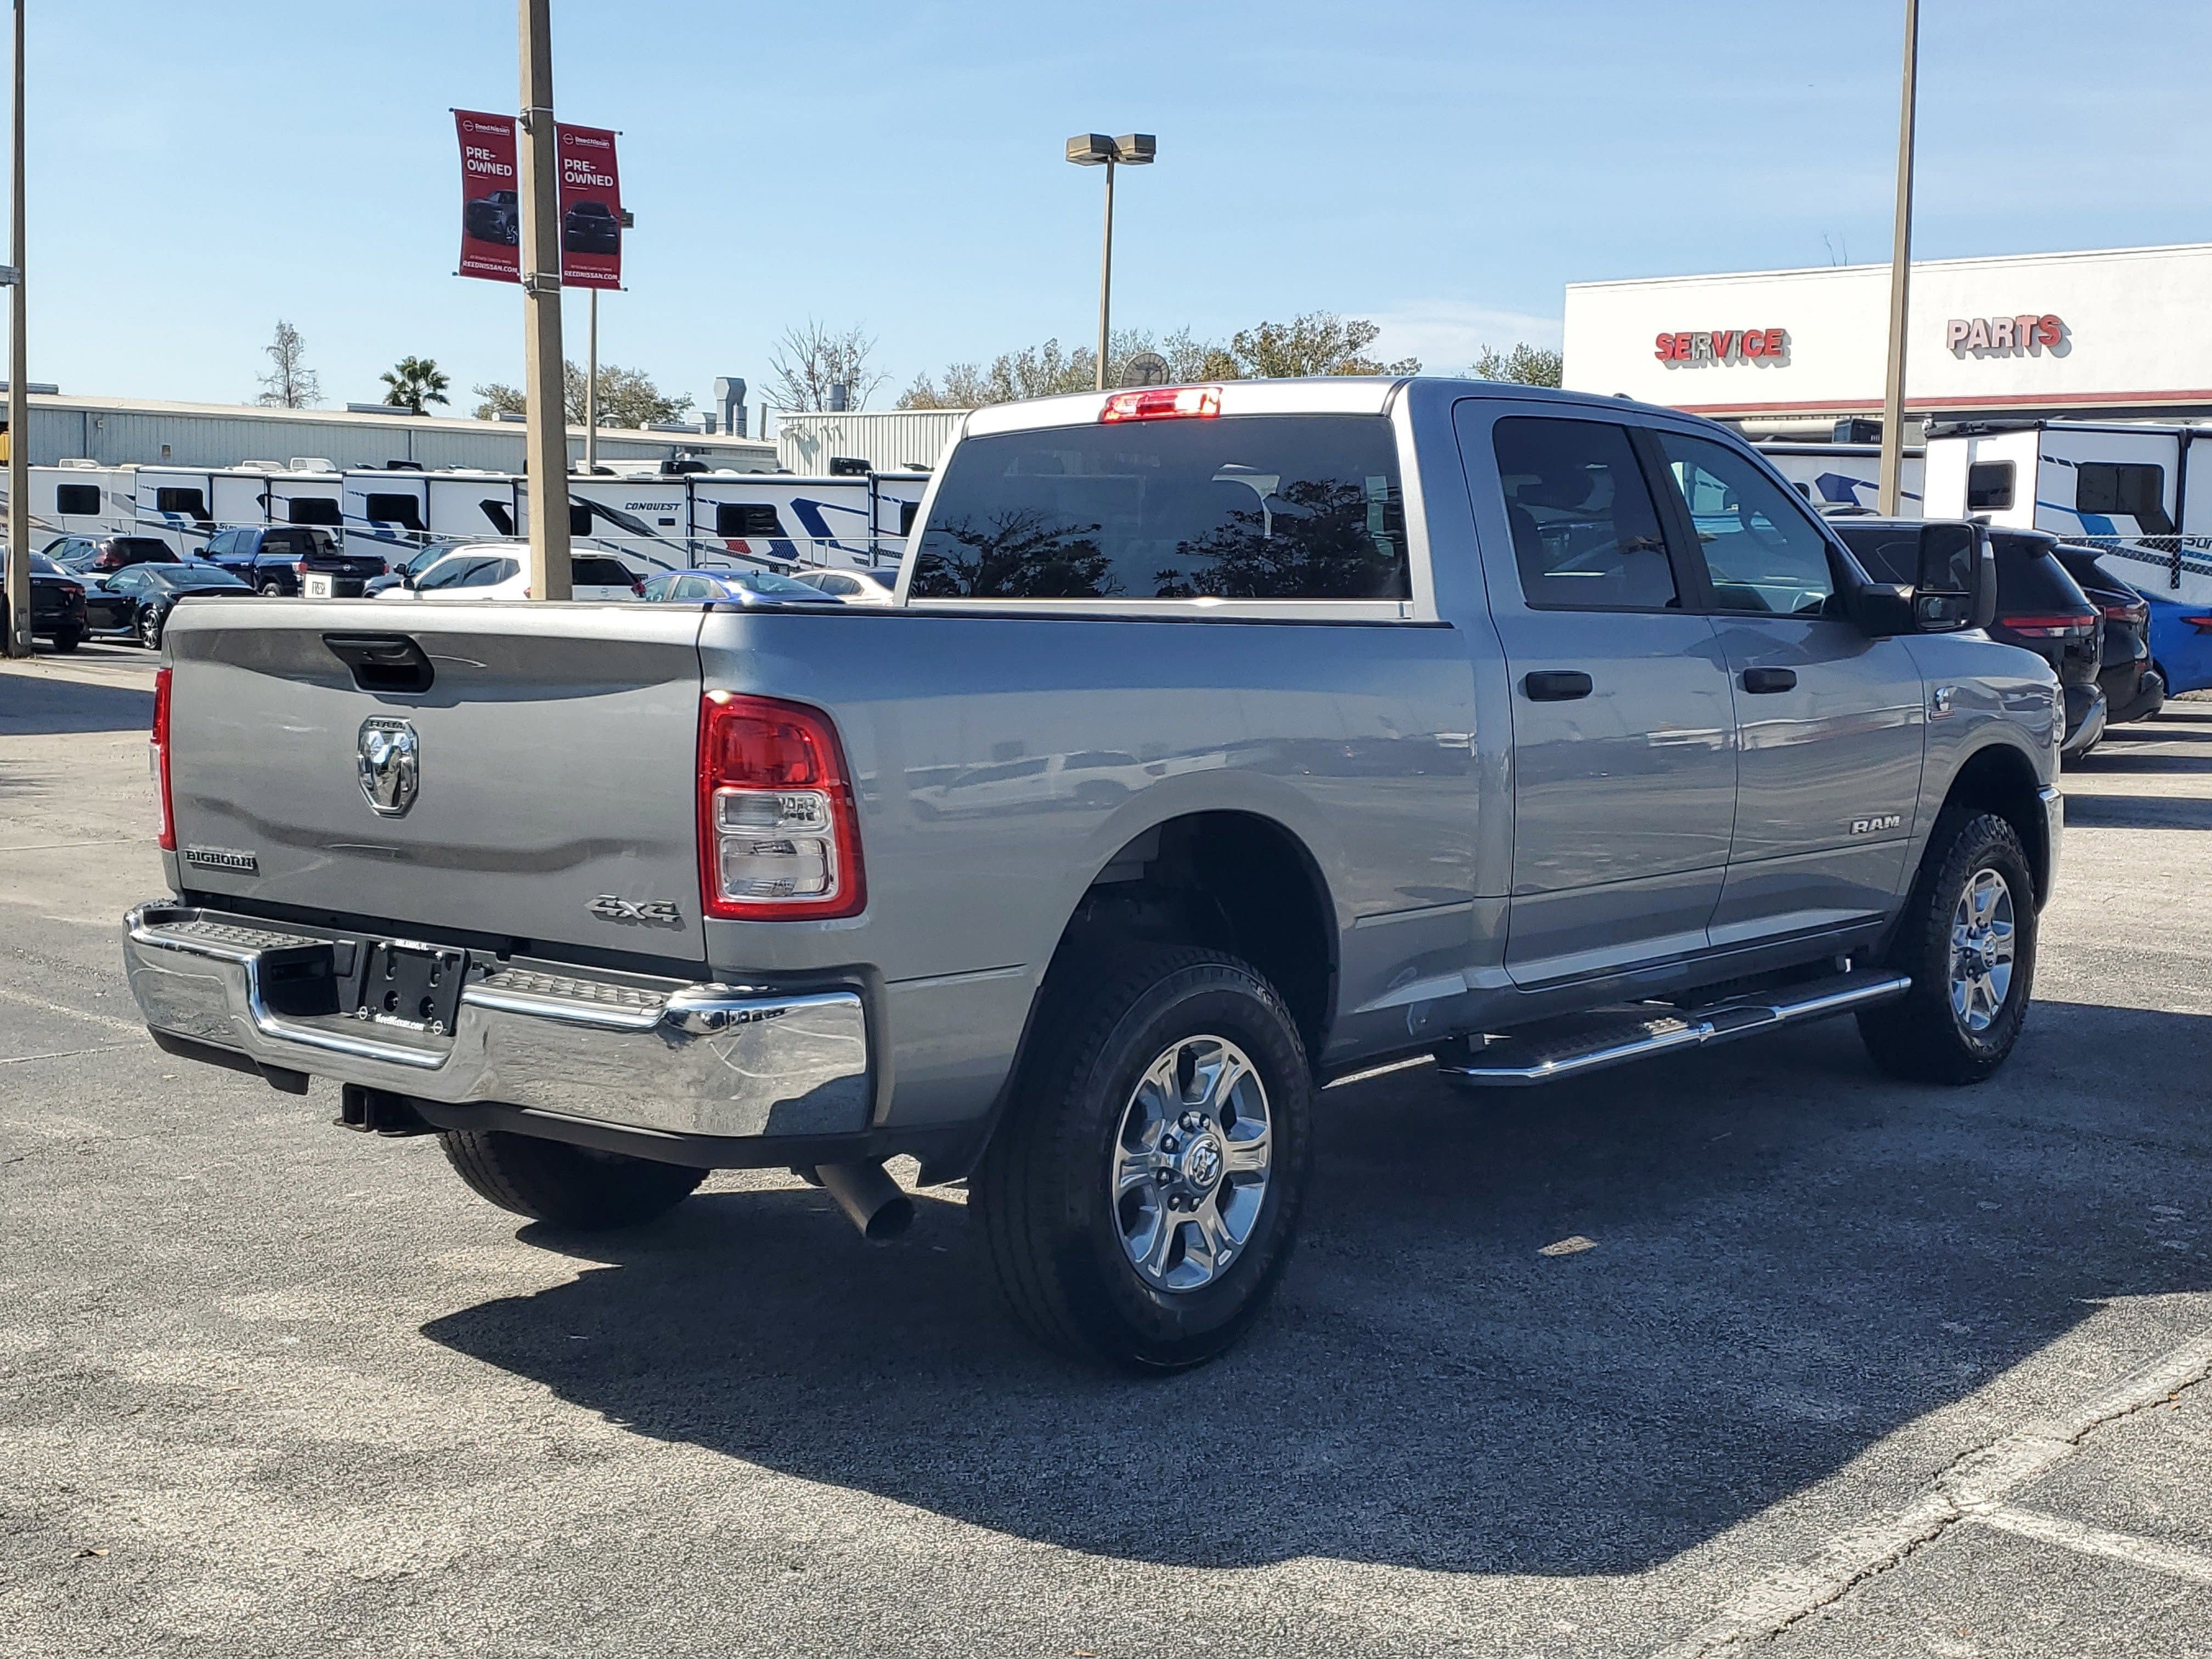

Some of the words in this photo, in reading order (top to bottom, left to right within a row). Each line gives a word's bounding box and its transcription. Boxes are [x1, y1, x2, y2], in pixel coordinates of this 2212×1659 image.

[466, 146, 496, 160] PRE-
[467, 159, 512, 177] OWNED
[564, 158, 596, 172] PRE-
[565, 171, 613, 187] OWNED
[462, 261, 518, 273] REEDNISSAN.COM
[564, 270, 618, 280] REEDNISSAN.COM
[1947, 314, 2062, 349] PARTS
[1655, 328, 1787, 361] SERVICE
[1850, 814, 1900, 834] RAM
[185, 849, 255, 870] BIGHORN
